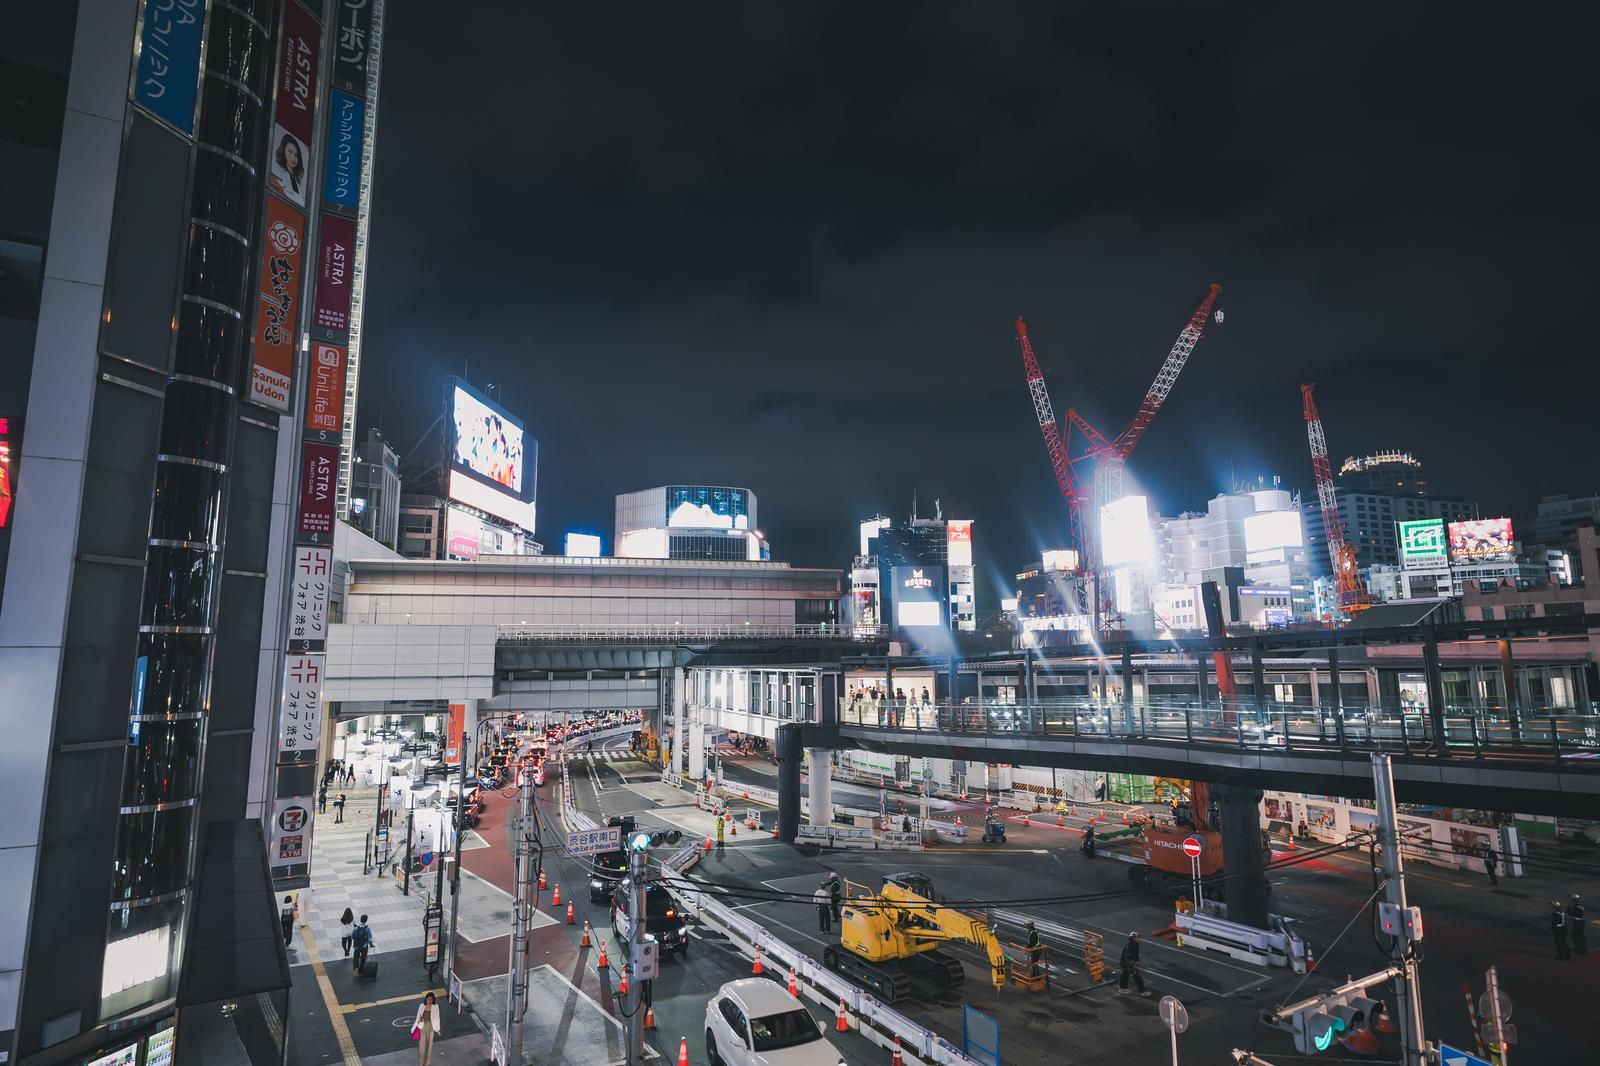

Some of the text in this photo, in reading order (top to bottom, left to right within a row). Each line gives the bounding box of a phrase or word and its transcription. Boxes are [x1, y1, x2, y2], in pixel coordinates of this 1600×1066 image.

[292, 36, 312, 112] ASTRA
[332, 243, 345, 285] ASTRA
[327, 330, 333, 339] 6
[253, 368, 290, 391] Sanuki
[315, 366, 331, 413] UniLife
[255, 382, 285, 402] Udon
[320, 431, 326, 440] 5
[316, 456, 330, 501] ASTRA
[311, 532, 318, 542] 4
[294, 582, 309, 637] フォア 渋谷
[311, 582, 325, 632] クリニック
[303, 640, 310, 650] 3
[285, 690, 301, 748] フォア 渋谷
[303, 690, 317, 742] クリニック
[294, 751, 301, 761] 2
[569, 832, 617, 846] 渋谷駅南口
[1154, 839, 1184, 850] HITACHI
[281, 850, 301, 858] ATM
[286, 865, 292, 875] 1
